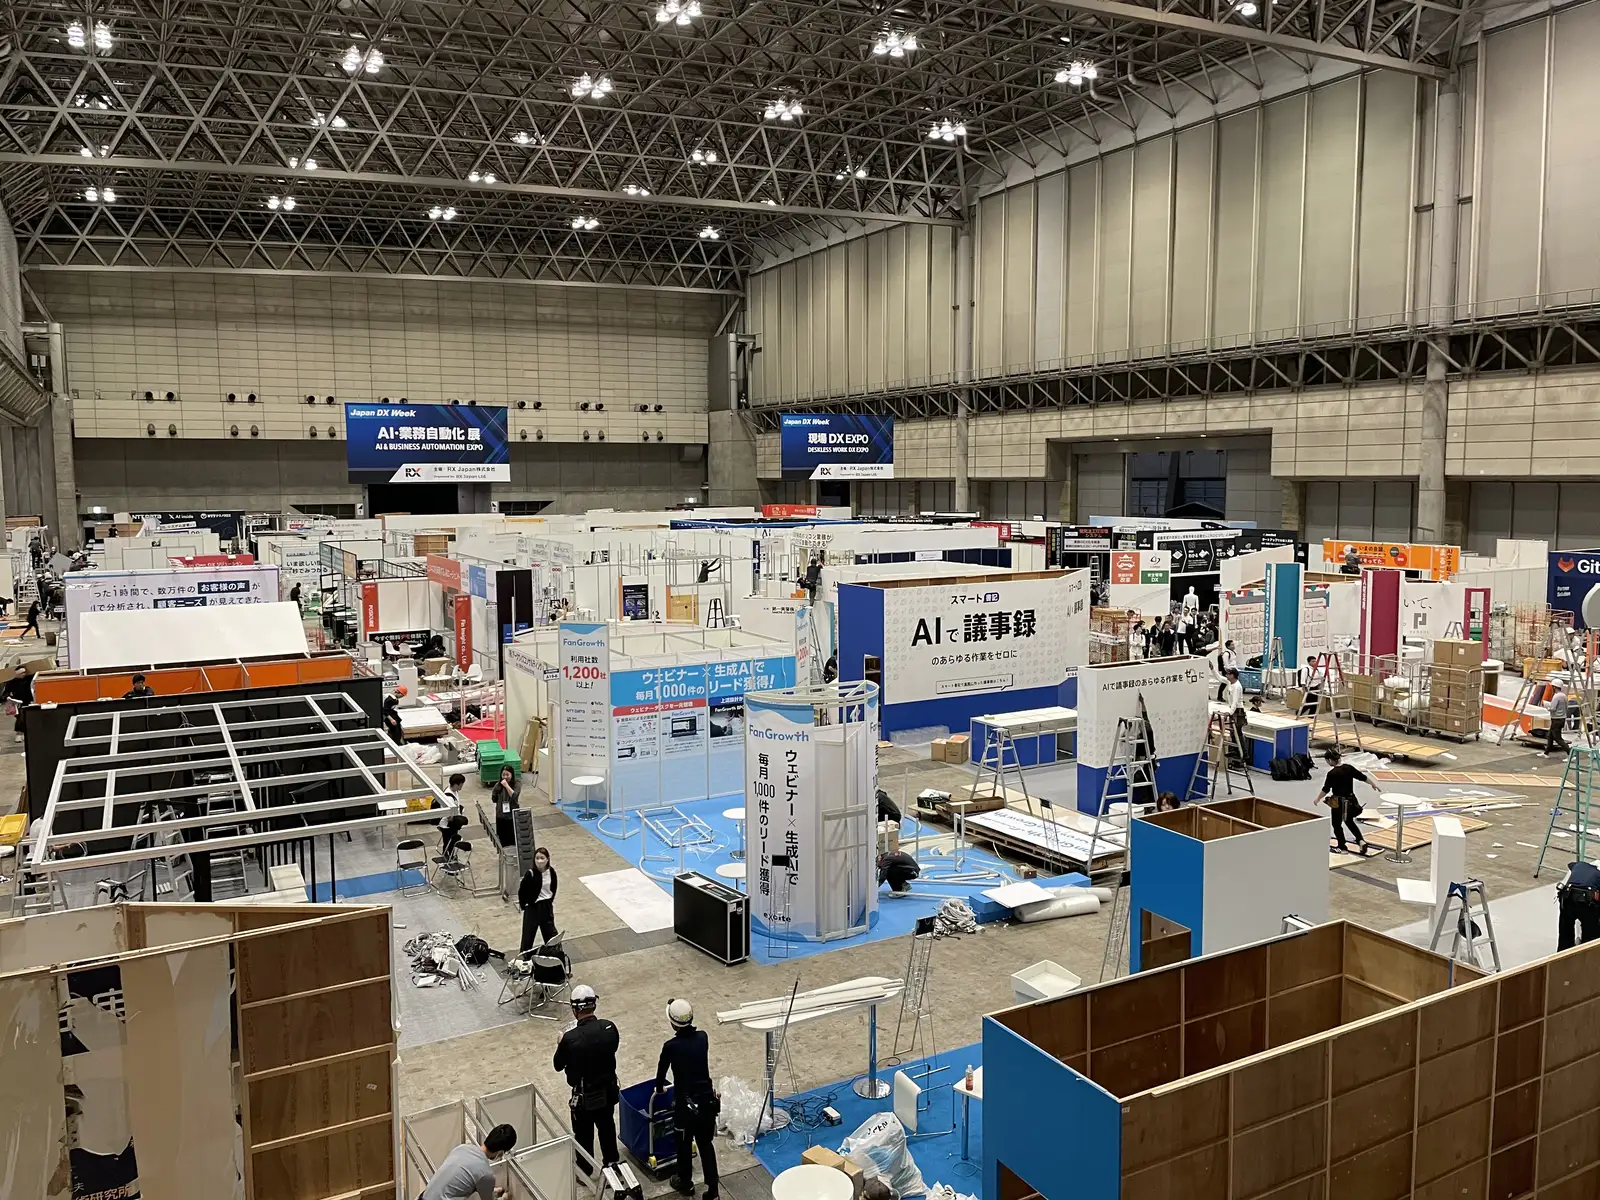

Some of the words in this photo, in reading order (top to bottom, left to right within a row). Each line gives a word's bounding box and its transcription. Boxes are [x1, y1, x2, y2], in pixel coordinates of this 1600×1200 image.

[468, 428, 480, 440] 展
[808, 433, 827, 444] 現場
[829, 434, 844, 444] DX
[846, 434, 868, 444] EXPO
[406, 468, 421, 477] RX
[200, 582, 246, 592] お客様の声
[911, 609, 1037, 647] AIで議事録
[563, 639, 605, 647] FanGrowth
[932, 650, 1018, 666] のあらゆる作業をゼロに
[563, 666, 606, 680] 1,200社
[749, 724, 809, 742] FanGrowth
